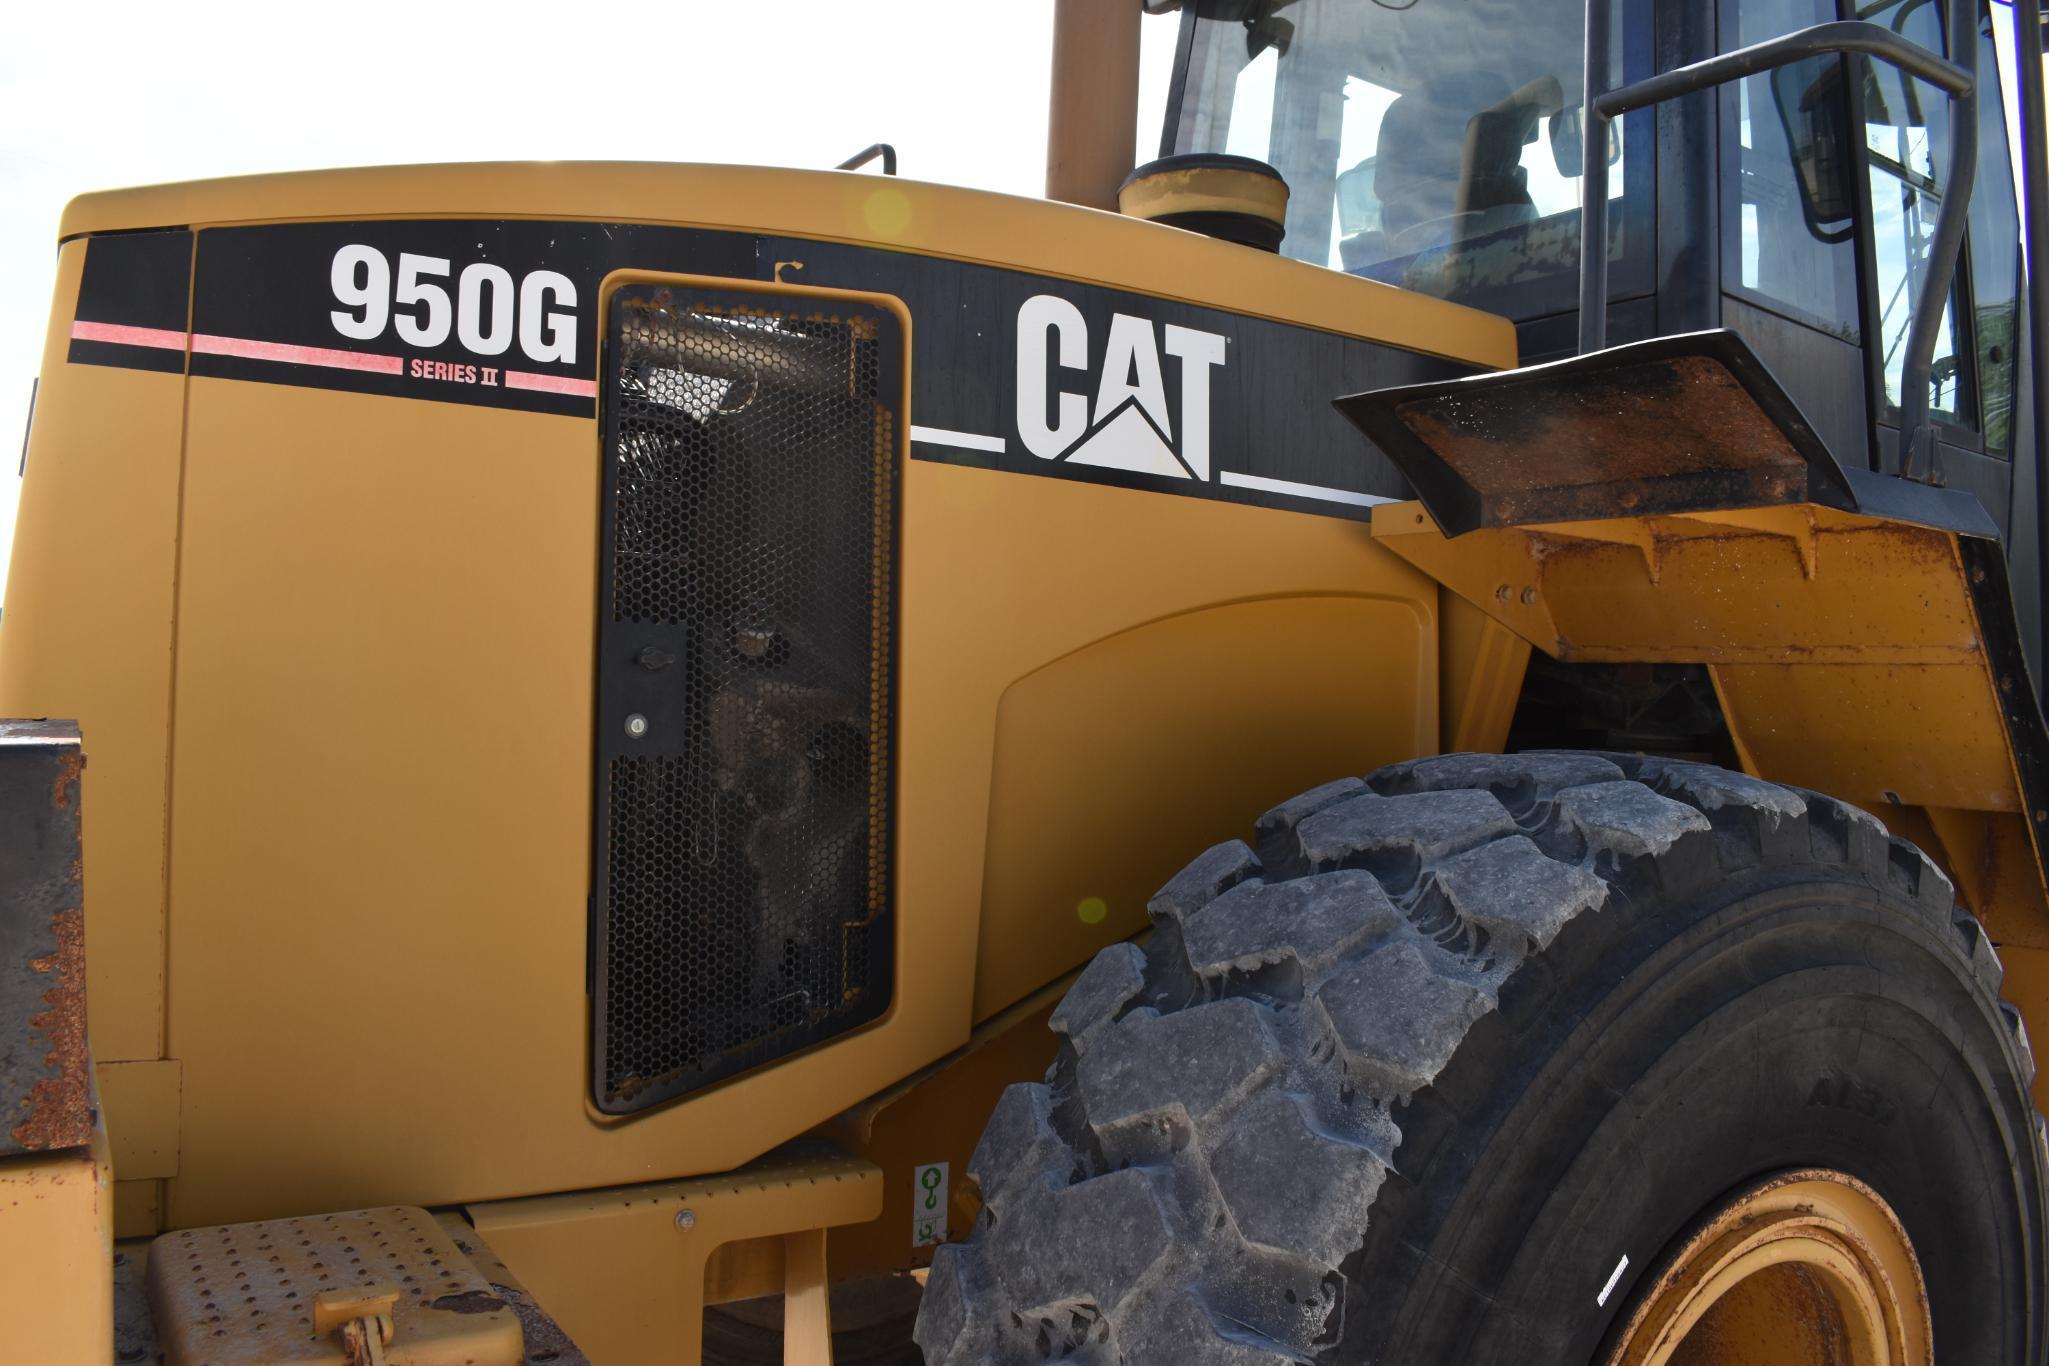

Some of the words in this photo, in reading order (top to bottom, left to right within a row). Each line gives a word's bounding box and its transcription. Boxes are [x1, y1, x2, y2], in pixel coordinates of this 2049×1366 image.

[330, 243, 578, 364] 950G
[410, 358, 477, 384] SERIES
[480, 366, 499, 387] II
[1016, 294, 1226, 482] CAT
